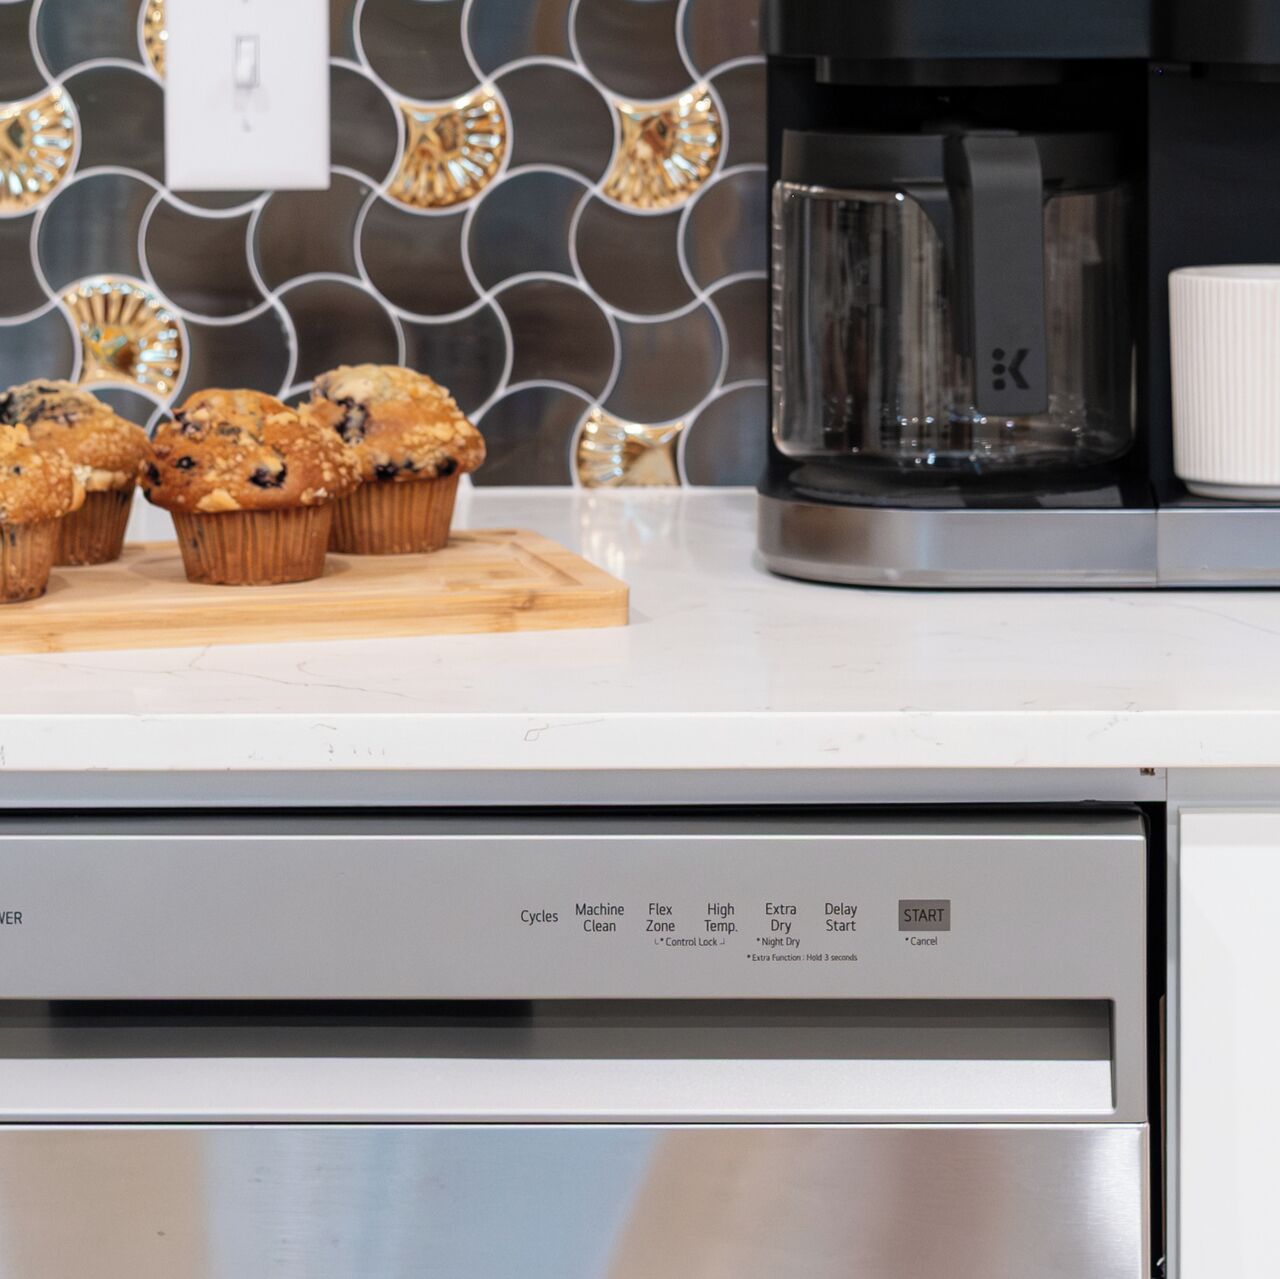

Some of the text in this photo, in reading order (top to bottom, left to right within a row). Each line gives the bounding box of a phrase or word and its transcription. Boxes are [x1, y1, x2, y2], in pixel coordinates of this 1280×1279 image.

[575, 902, 625, 916] Machine
[648, 902, 673, 916] Flex
[707, 902, 735, 919] High
[765, 902, 797, 916] Extra
[824, 902, 858, 919] Delay
[903, 908, 945, 923] START
[520, 908, 559, 927] Cycles
[583, 919, 617, 933] Clean
[645, 919, 676, 933] Zone
[703, 919, 739, 935] Temp.
[770, 919, 793, 935] Dry
[824, 918, 857, 932] Start
[665, 936, 718, 947] Control Lock
[761, 936, 801, 948] Night Dry
[910, 935, 938, 946] Cancel
[751, 953, 771, 962] Extra
[806, 953, 823, 962] Hold
[831, 953, 859, 962] seconds
